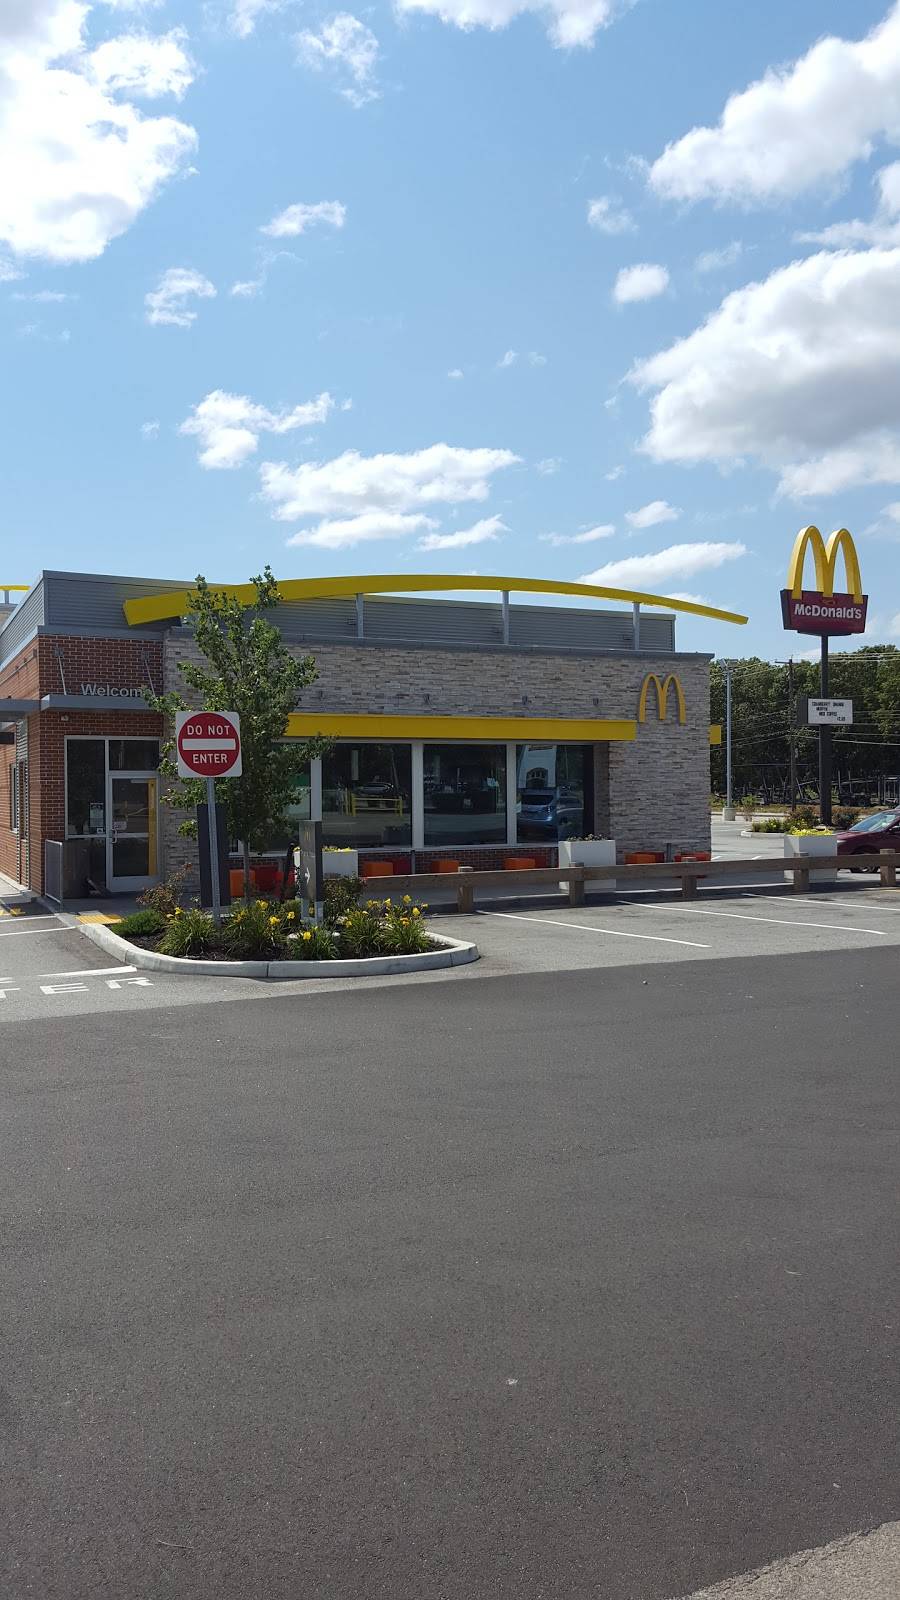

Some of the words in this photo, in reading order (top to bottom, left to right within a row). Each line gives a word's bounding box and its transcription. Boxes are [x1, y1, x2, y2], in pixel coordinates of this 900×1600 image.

[794, 603, 862, 619] McDonald's
[81, 683, 143, 697] Welcom
[187, 725, 203, 736] DO
[208, 725, 230, 736] NOT
[192, 753, 228, 764] ENTER
